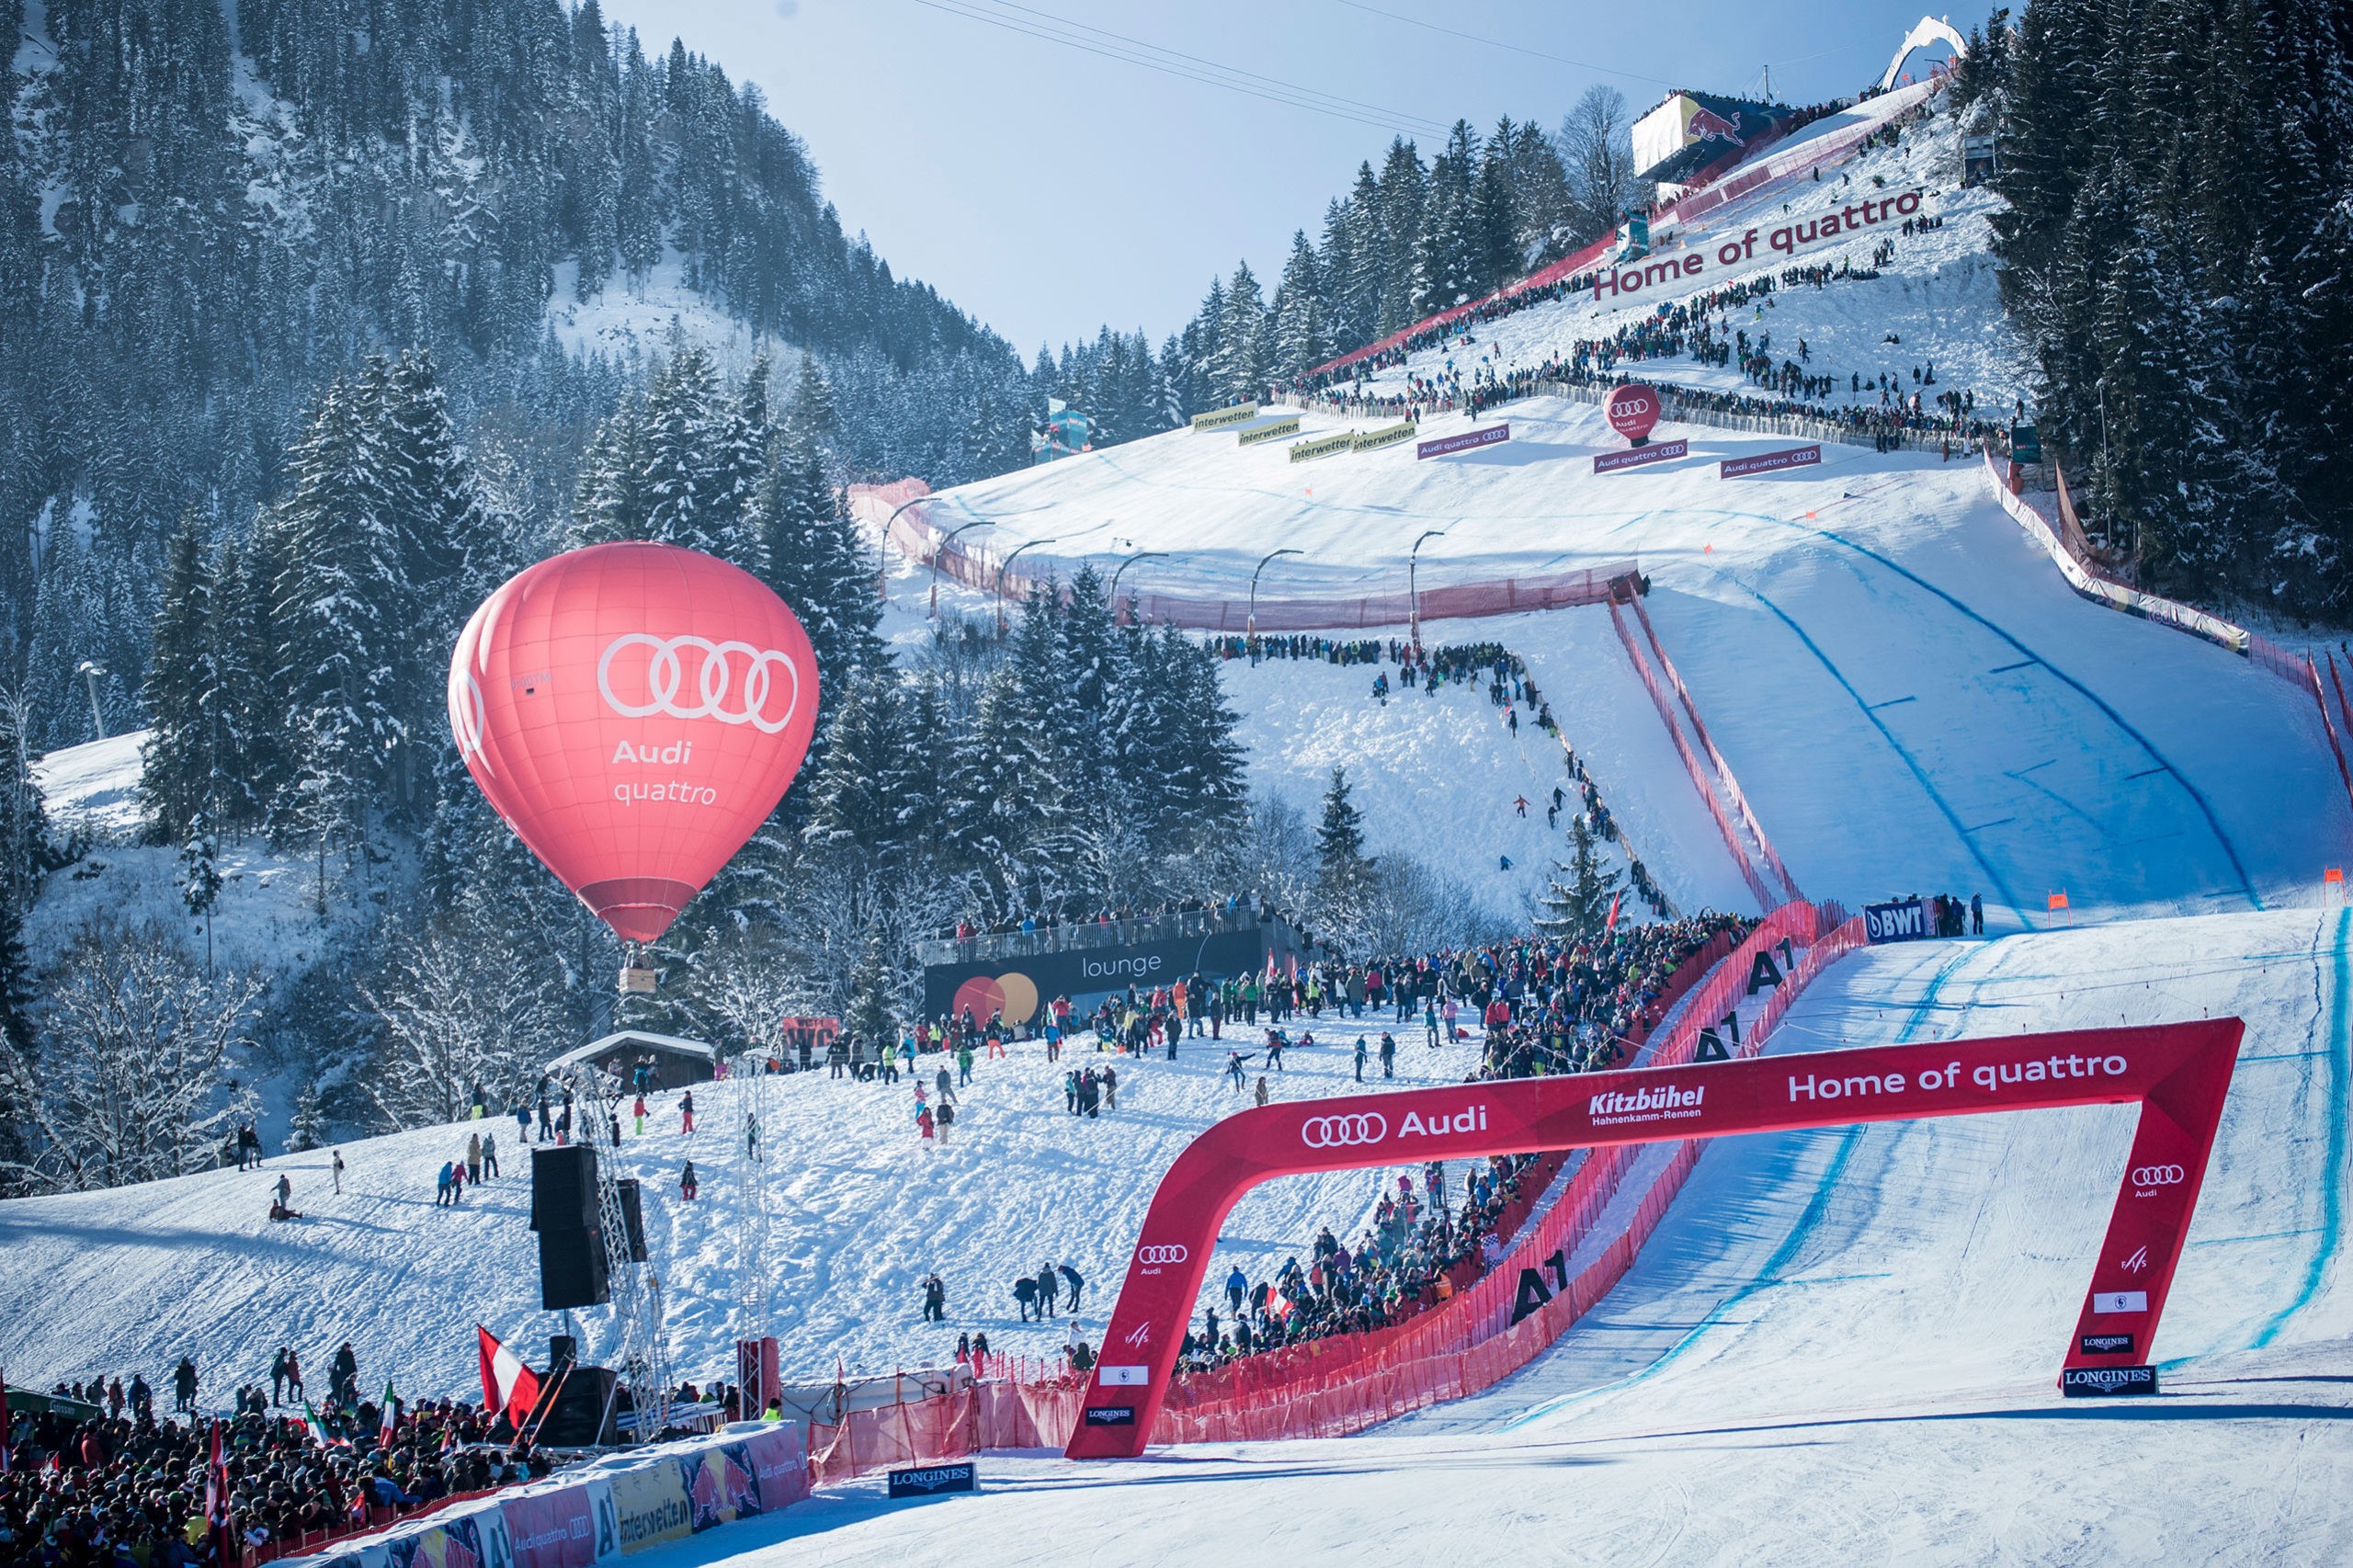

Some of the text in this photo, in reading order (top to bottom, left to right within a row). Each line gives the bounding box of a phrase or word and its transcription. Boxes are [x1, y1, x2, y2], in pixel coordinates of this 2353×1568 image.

[1593, 191, 1921, 301] Home of quattro
[1195, 409, 1256, 429] interwetten
[1616, 419, 1637, 427] Audi
[1239, 421, 1300, 445] interwetten
[1353, 426, 1415, 450] interwetten
[1420, 437, 1479, 456] Audi quattro
[1597, 450, 1657, 469] Audi quattro
[1723, 457, 1788, 473] Audi quattro
[612, 740, 692, 765] Audi
[614, 779, 717, 807] quattro
[1881, 906, 1922, 936] BWT
[1082, 955, 1162, 979] lounge
[1747, 937, 1794, 995] A1
[787, 1028, 835, 1050] WC
[1789, 1052, 2128, 1102] Home of quattro
[1588, 1085, 1705, 1116] Kitzbühel
[1397, 1105, 1487, 1138] Audi
[1592, 1108, 1701, 1126] Hahnenkamm-Rennen
[2135, 1189, 2157, 1198] Audi
[1141, 1267, 1162, 1276] Audi
[1510, 1249, 1568, 1326] A1
[2084, 1336, 2128, 1346] LONGINES
[2065, 1369, 2153, 1384] LONGINES
[1088, 1409, 1131, 1418] LONGINES
[893, 1468, 969, 1485] LONGINES
[598, 1486, 617, 1558] A1
[514, 1535, 536, 1552] Audi
